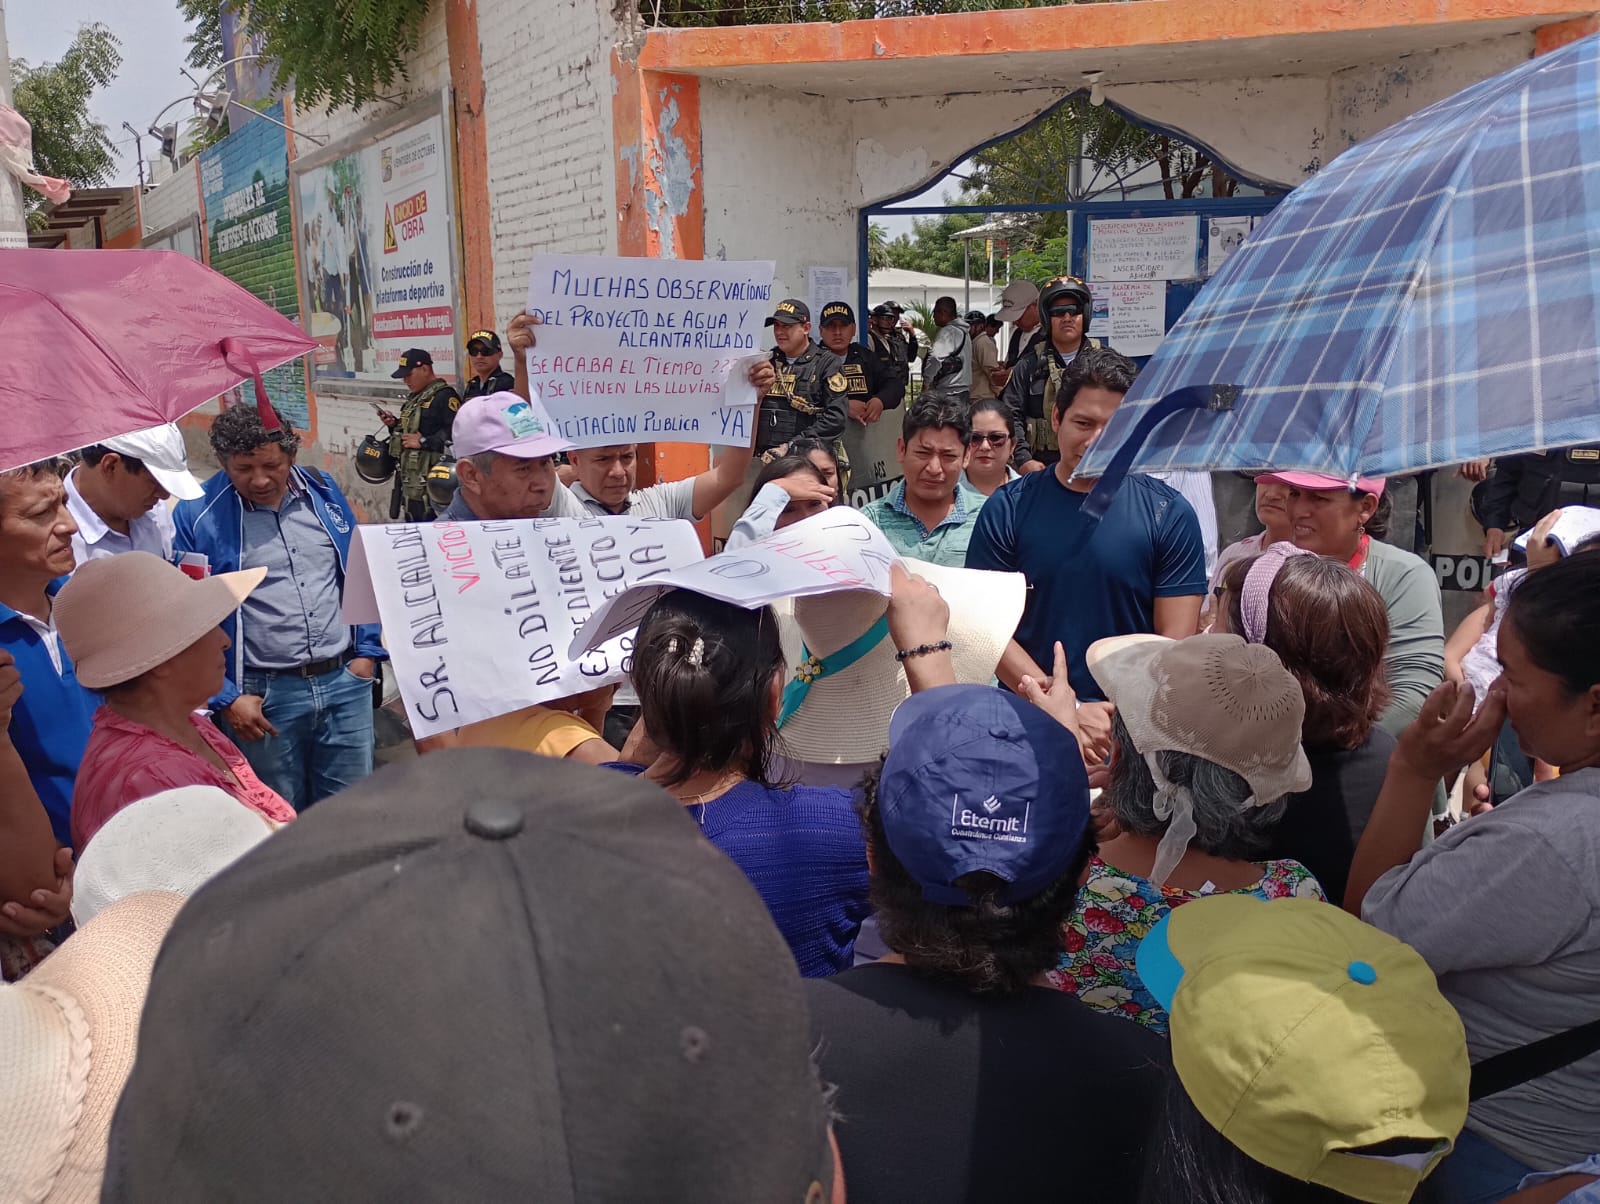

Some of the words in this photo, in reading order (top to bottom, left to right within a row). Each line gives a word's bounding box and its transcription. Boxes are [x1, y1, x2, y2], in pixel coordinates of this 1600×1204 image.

[402, 216, 425, 241] OBRA
[381, 260, 421, 282] Construcción
[423, 258, 434, 276] de
[408, 281, 445, 304] deportiva
[552, 268, 649, 298] MUCHAS
[570, 305, 649, 328] PROYECTO
[654, 312, 677, 328] DE
[682, 310, 728, 329] AGUA
[733, 310, 749, 329] Y
[824, 306, 848, 318] POLICIA
[618, 330, 754, 349] ALCANTARILLADO
[531, 356, 548, 375] SE
[553, 356, 614, 374] ACABA
[620, 359, 636, 374] EL
[643, 356, 702, 376] TIEMPO
[536, 381, 544, 398] Y
[548, 379, 565, 398] SE
[570, 378, 626, 396] VIENEN
[635, 383, 660, 395] LAS
[528, 644, 560, 686] NO
[415, 655, 460, 722] SR.
[960, 809, 1020, 832] Eternit
